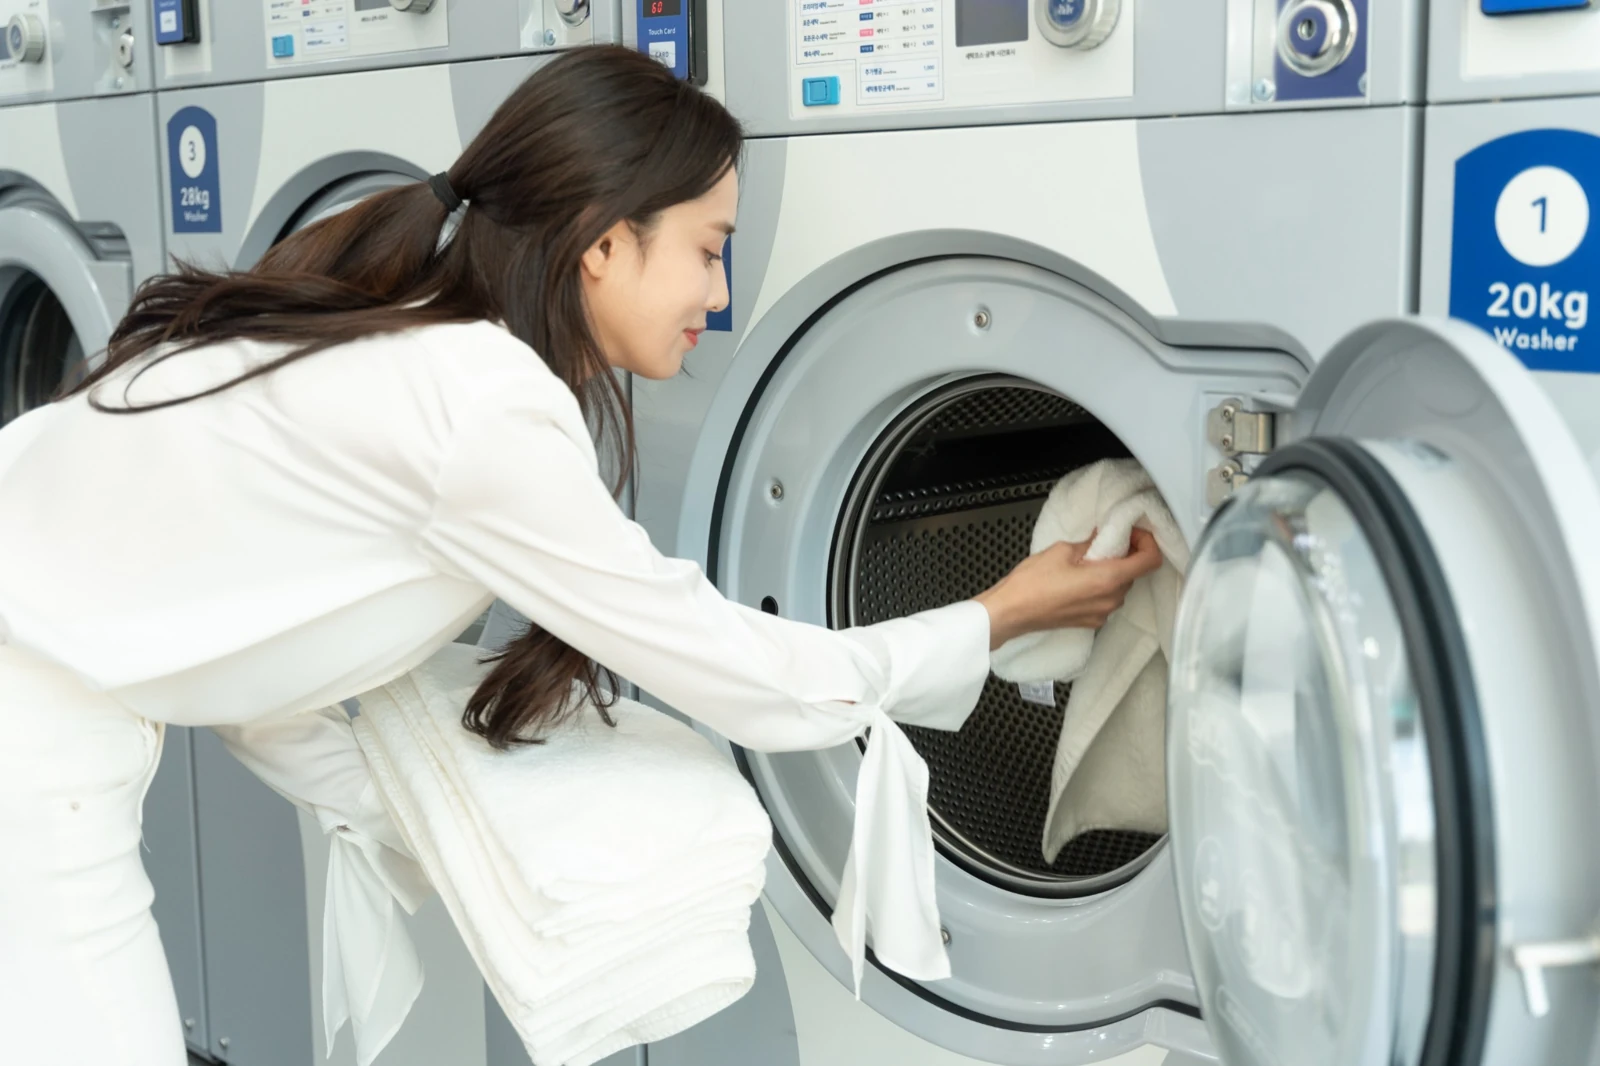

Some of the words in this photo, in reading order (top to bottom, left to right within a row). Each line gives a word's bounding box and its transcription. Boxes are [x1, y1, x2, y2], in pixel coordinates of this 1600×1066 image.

[652, 1, 663, 14] 60
[648, 28, 664, 36] Touch
[664, 27, 676, 35] Card
[188, 140, 196, 161] 3
[180, 186, 210, 210] 28kg
[1531, 195, 1548, 234] 1
[1486, 281, 1589, 330] 20kg
[1494, 326, 1578, 351] Washer
